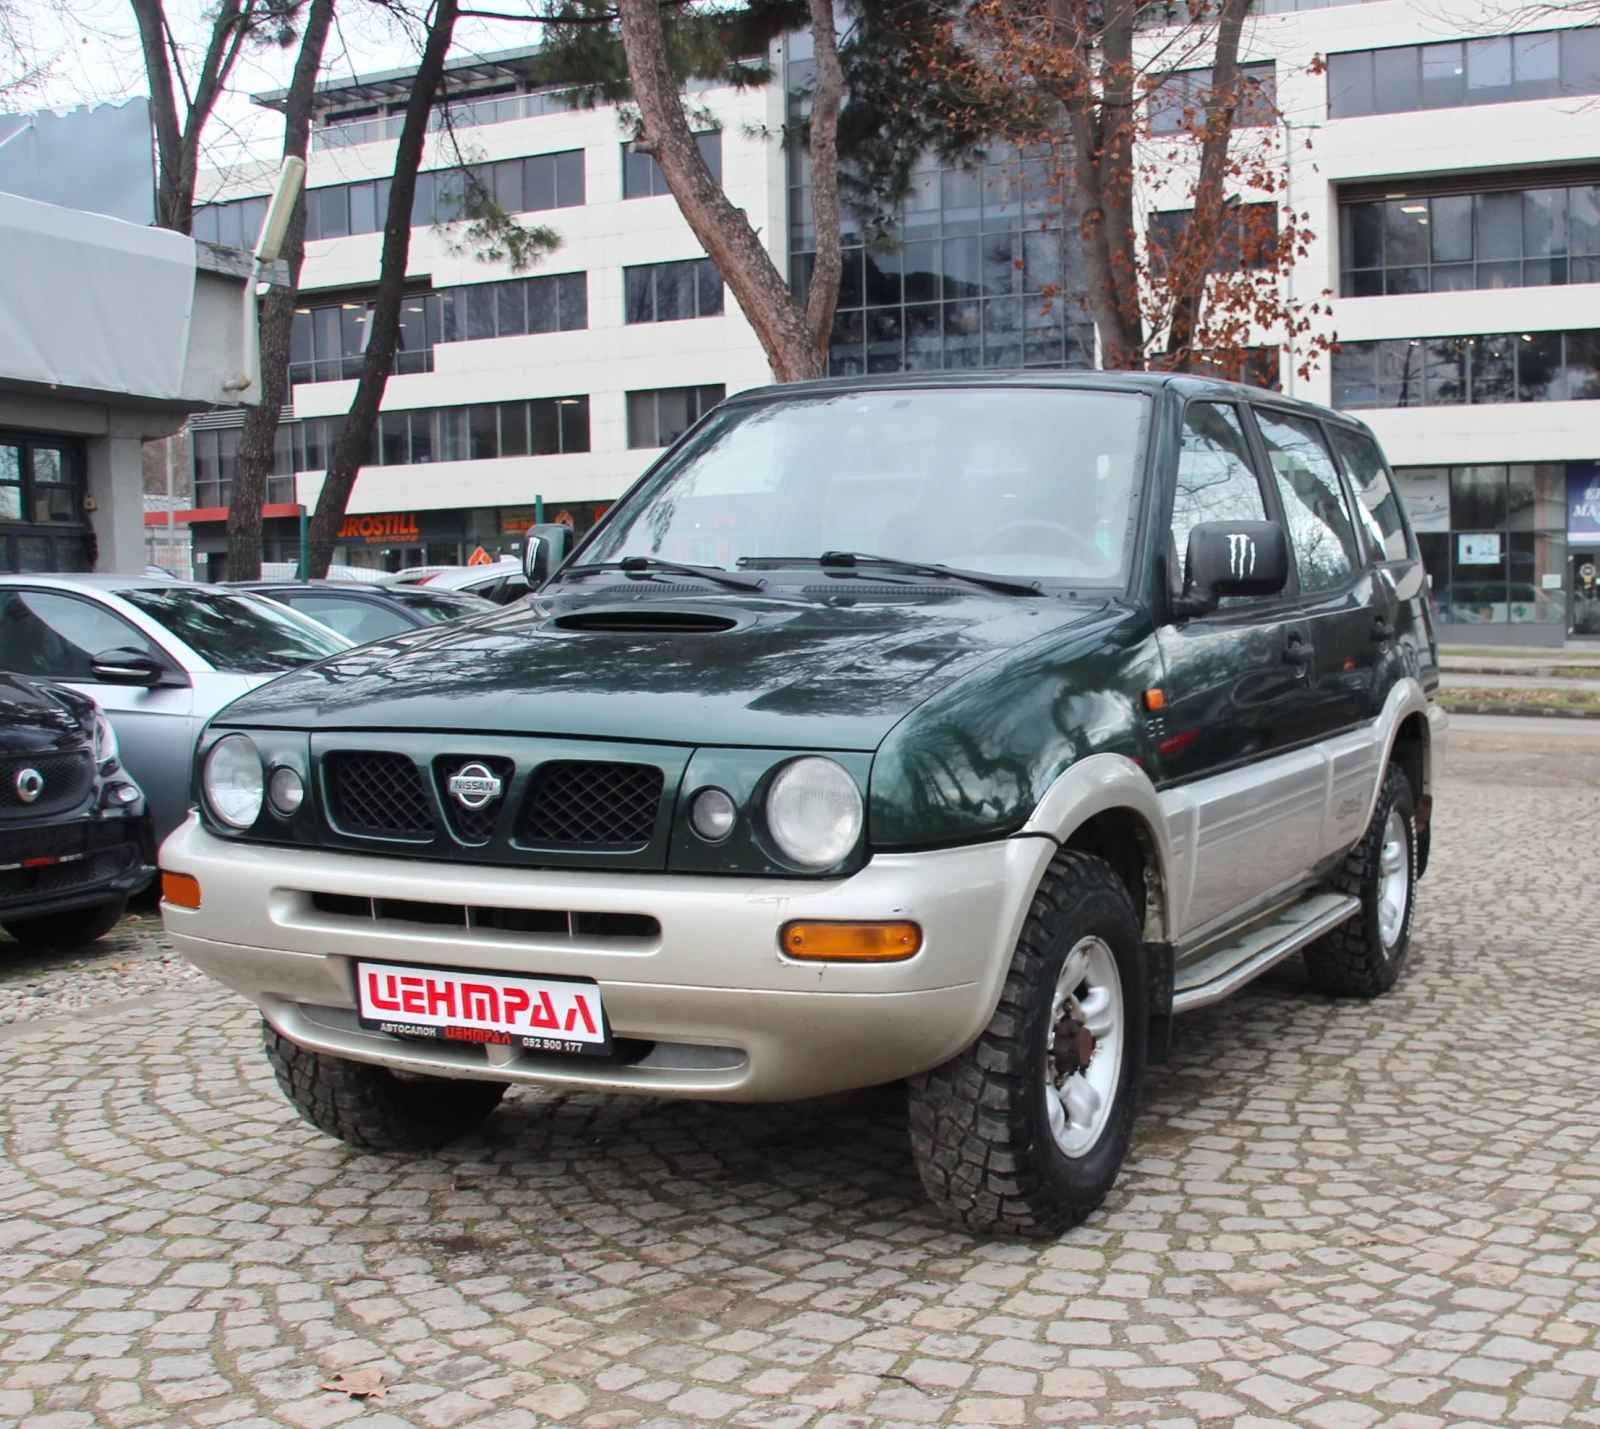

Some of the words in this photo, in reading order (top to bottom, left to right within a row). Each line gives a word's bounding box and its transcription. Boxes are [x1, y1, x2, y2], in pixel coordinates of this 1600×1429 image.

[454, 780, 494, 791] NISSAN
[367, 973, 598, 1034] ЦЕНТРАЛ
[380, 1023, 437, 1037] АВТОСАЛОН
[522, 1037, 542, 1049] 052
[543, 1039, 562, 1051] 500
[564, 1041, 583, 1053] 177
